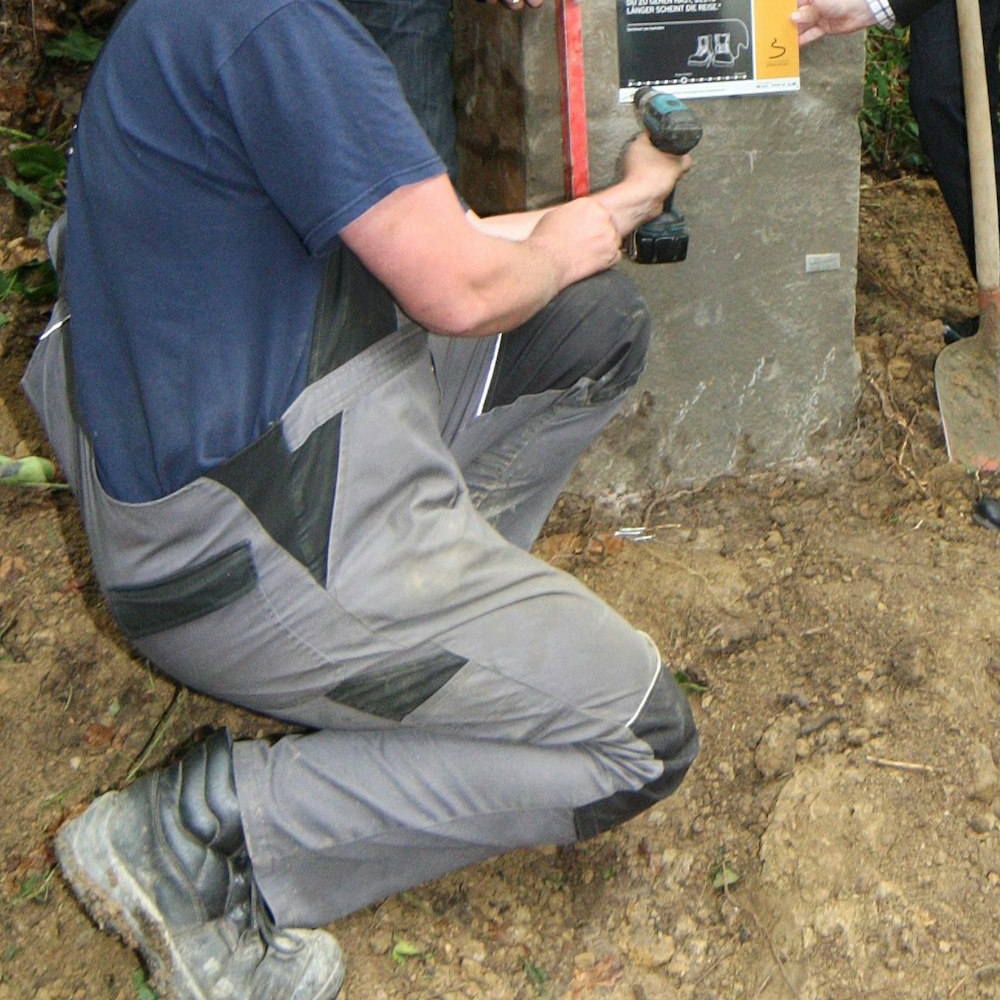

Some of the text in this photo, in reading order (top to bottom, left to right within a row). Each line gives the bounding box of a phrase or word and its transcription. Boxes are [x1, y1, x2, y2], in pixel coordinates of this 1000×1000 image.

[626, 4, 655, 15] LÄNGER
[655, 4, 684, 14] SCHEINT
[685, 4, 697, 13] DIE
